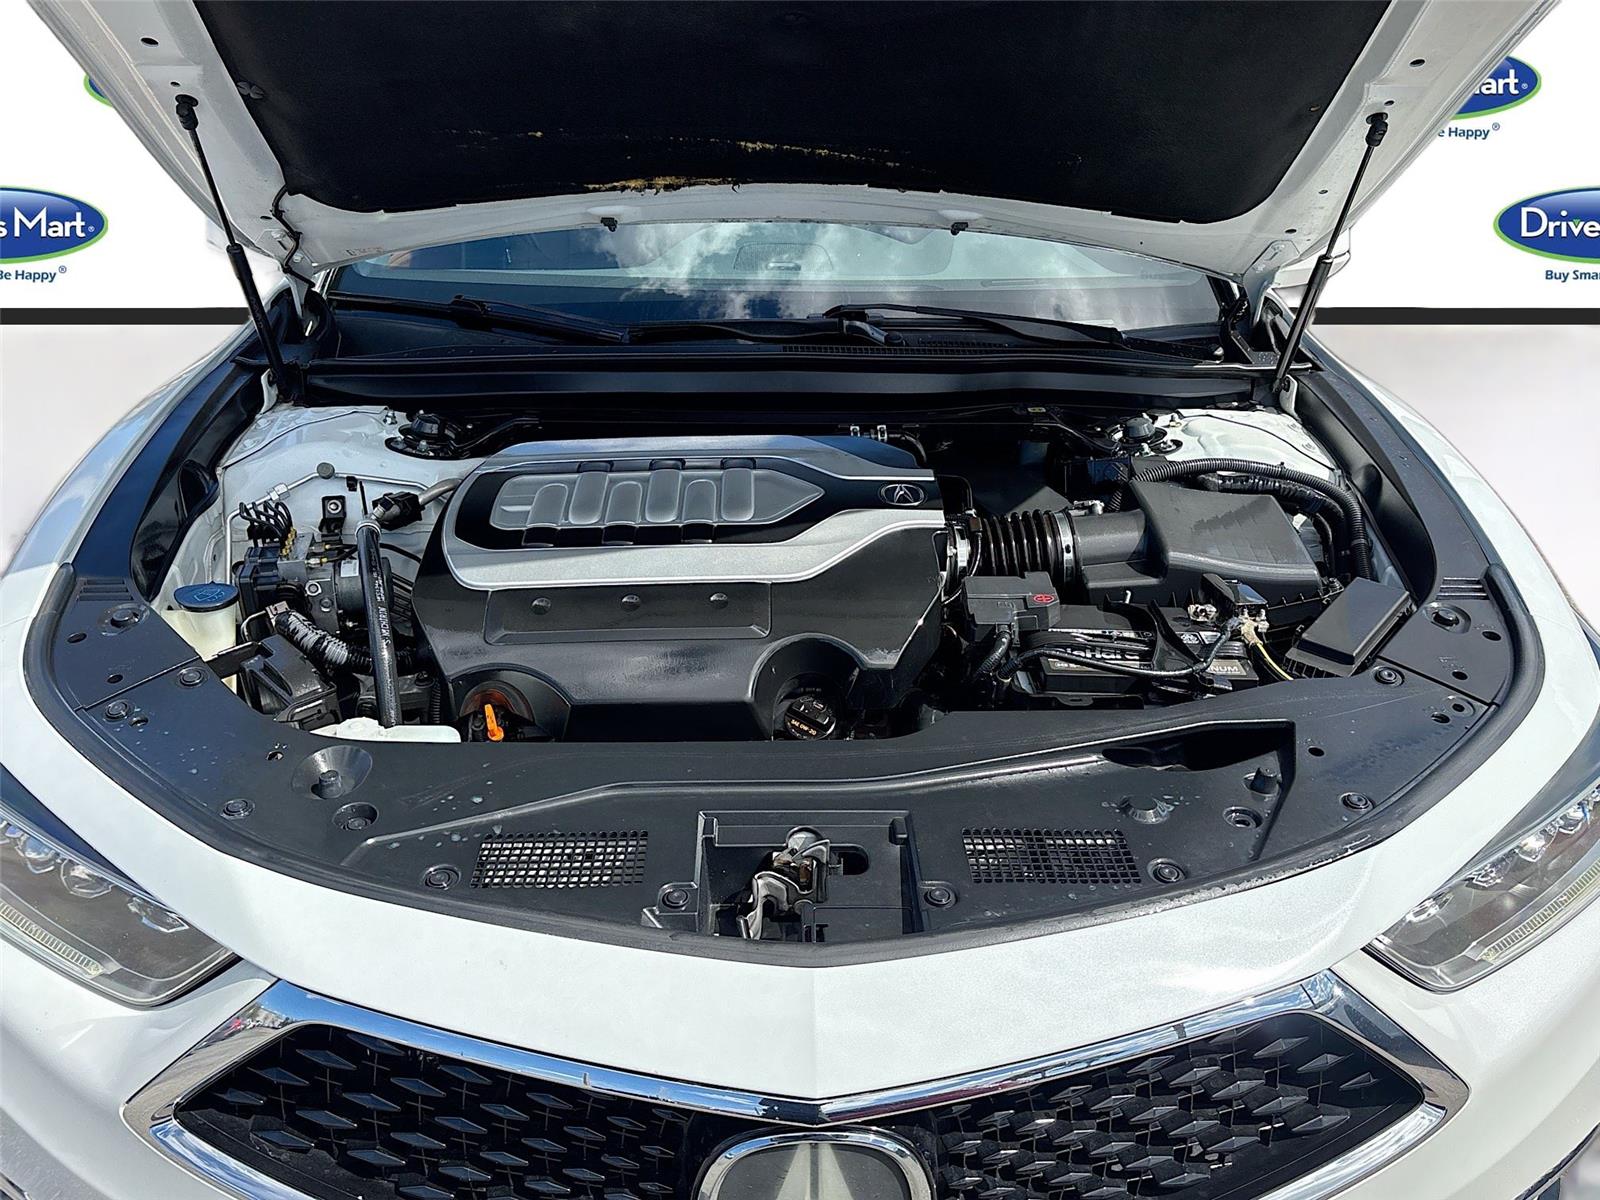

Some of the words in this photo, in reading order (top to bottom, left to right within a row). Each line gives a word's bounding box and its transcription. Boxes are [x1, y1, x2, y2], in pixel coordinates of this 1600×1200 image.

[1474, 69, 1519, 94] art
[1448, 127, 1490, 140] Happy
[14, 207, 86, 238] Mart
[15, 270, 57, 283] Happy
[1545, 270, 1570, 283] Buy
